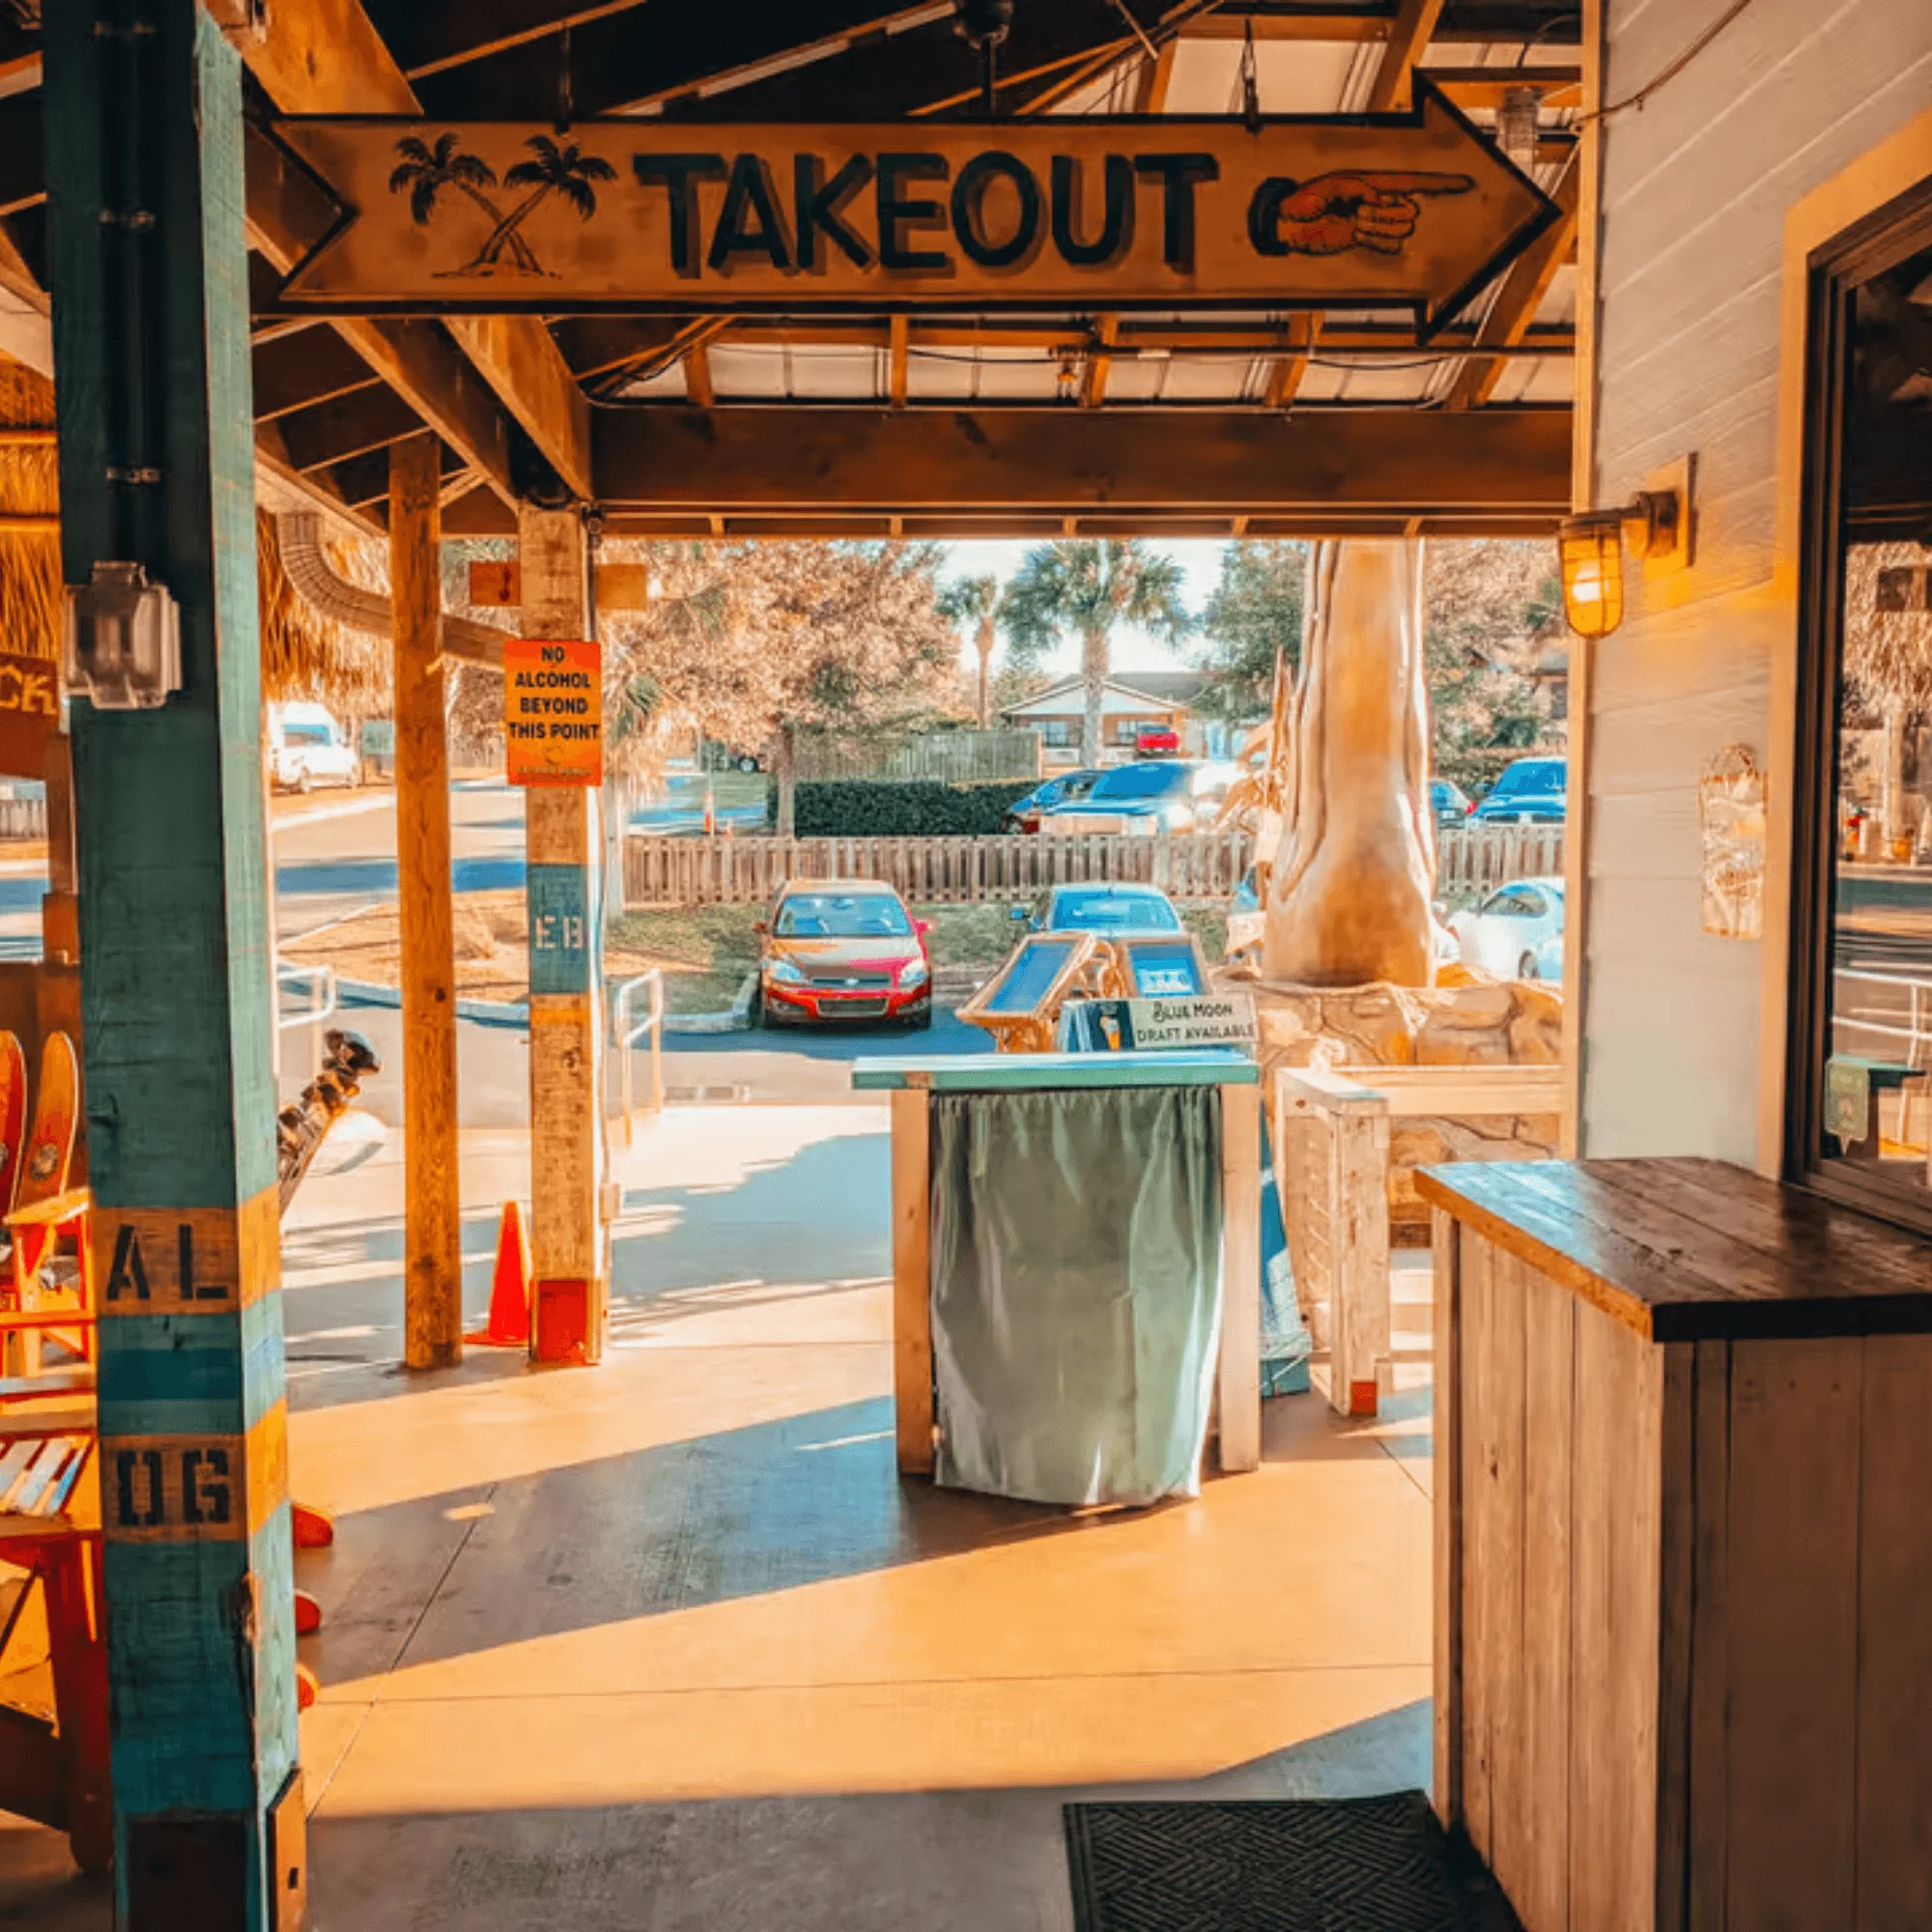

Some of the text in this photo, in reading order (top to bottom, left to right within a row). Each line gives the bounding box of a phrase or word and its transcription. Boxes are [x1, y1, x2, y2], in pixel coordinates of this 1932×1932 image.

[633, 151, 1219, 279] TAKEOUT
[541, 646, 565, 664] NO
[515, 671, 591, 689] ALCOHOL
[520, 696, 588, 715] BEYOND
[509, 722, 600, 740] THIS POINT
[1193, 1002, 1233, 1019] MOON
[1137, 1023, 1255, 1042] DRAFT AVAILABLE
[106, 1224, 228, 1299] AL
